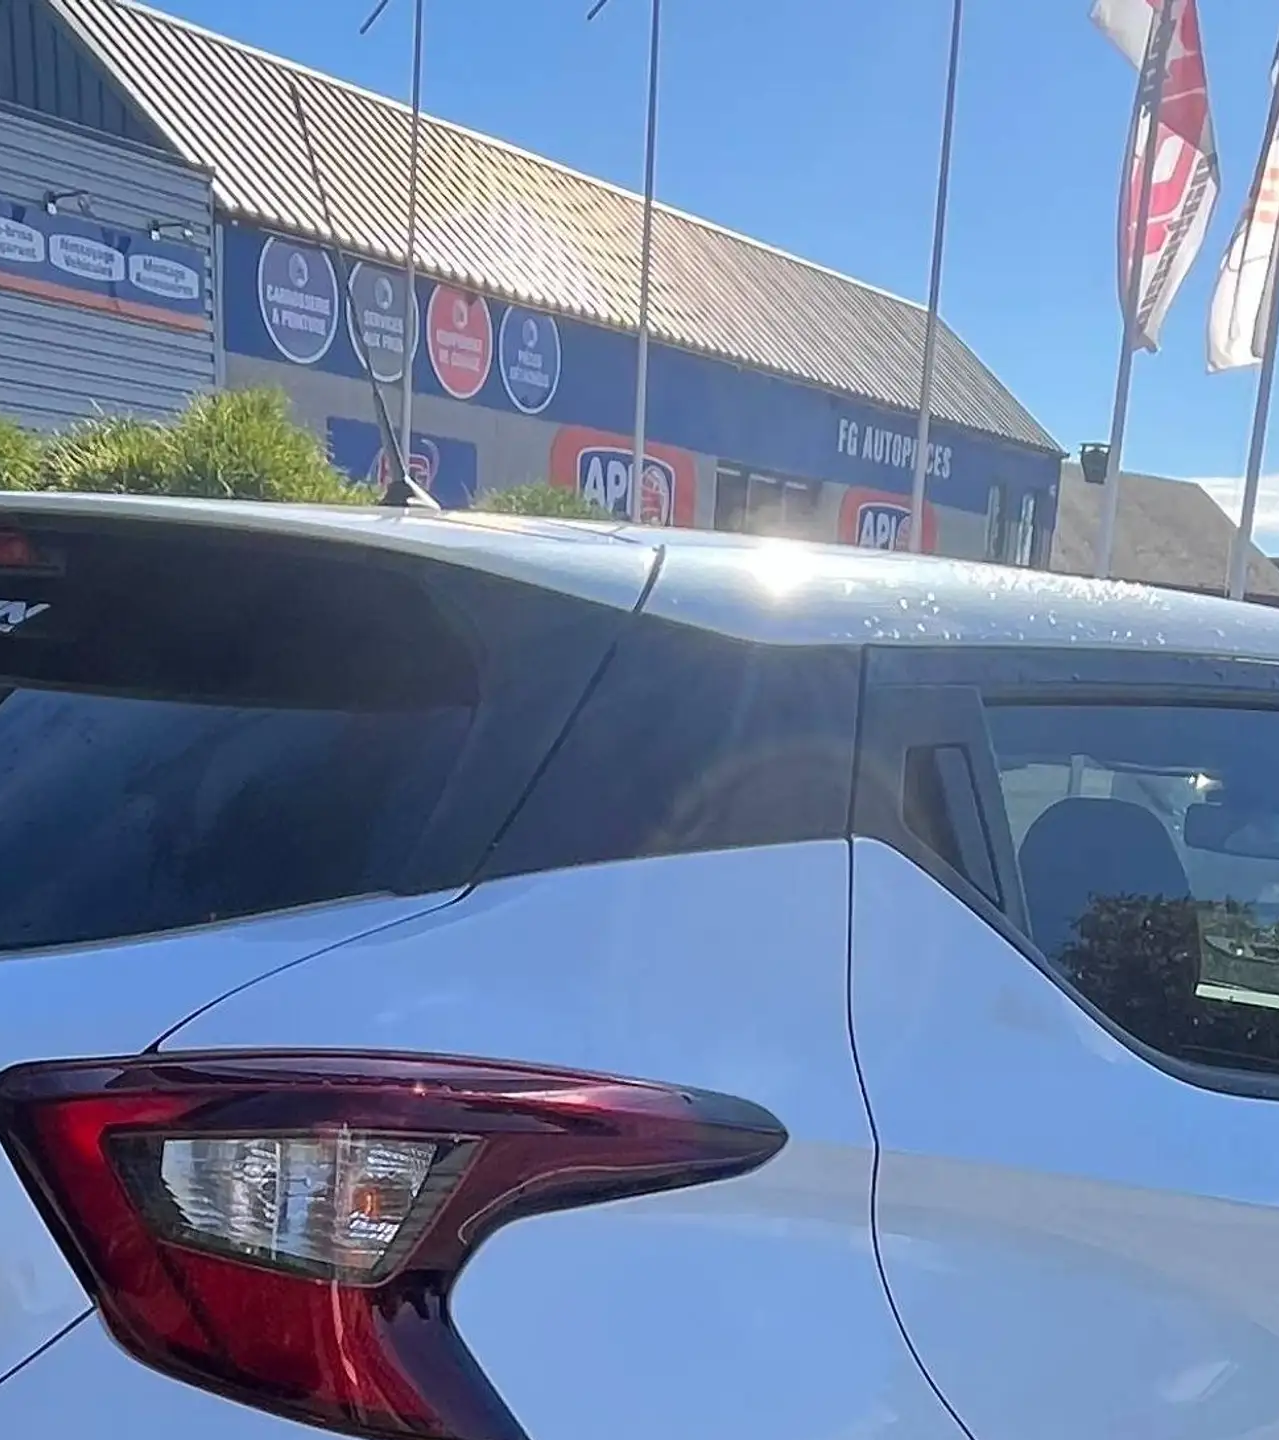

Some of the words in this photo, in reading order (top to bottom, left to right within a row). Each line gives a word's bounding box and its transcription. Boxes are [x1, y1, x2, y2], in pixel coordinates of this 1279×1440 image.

[837, 418, 859, 457] FG
[862, 425, 953, 479] AUTOPICES
[583, 455, 636, 522] API
[858, 510, 897, 551] API
